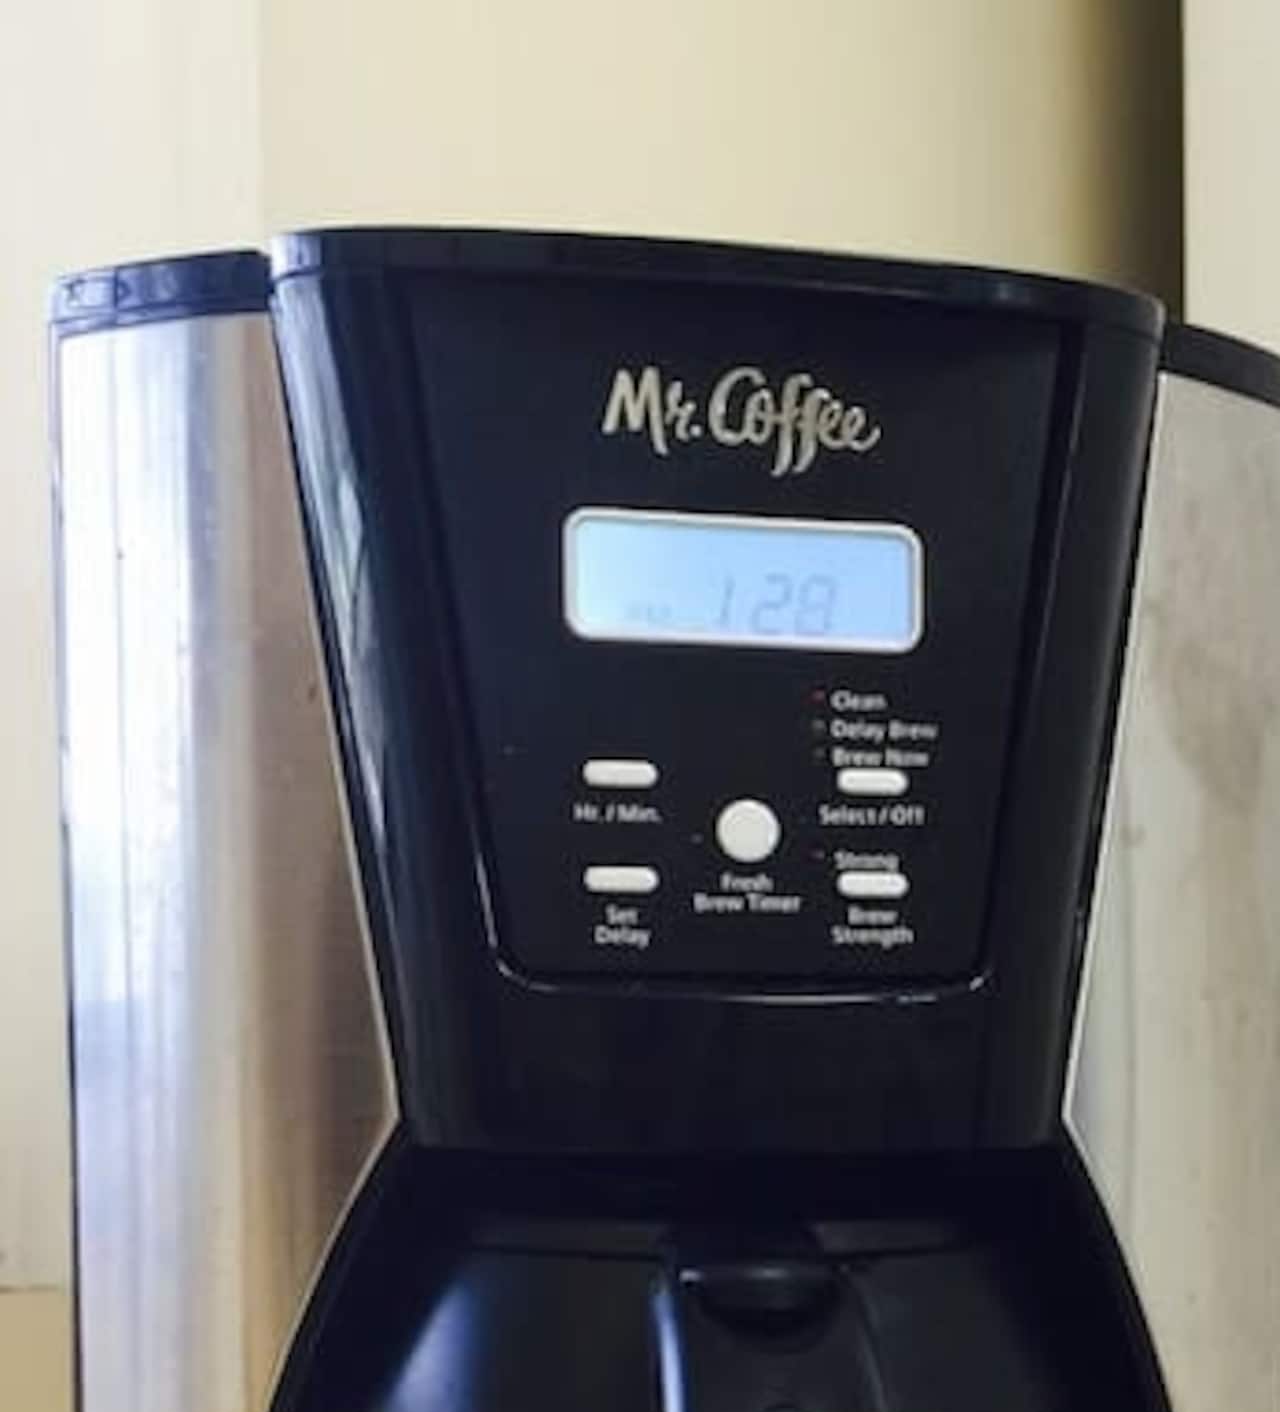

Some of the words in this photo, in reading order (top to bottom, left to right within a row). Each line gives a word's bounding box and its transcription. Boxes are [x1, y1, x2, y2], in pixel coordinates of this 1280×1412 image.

[602, 366, 701, 455] Mr.
[708, 366, 881, 477] Coffee
[831, 690, 887, 711] Clean
[831, 719, 884, 742] Delay
[889, 720, 938, 739] Brew
[833, 747, 882, 766] Brew
[886, 748, 929, 767] Now
[834, 850, 899, 872] Strong
[721, 872, 773, 892] Fresh
[694, 892, 745, 913] Brew
[746, 892, 801, 913] Timer
[606, 903, 639, 926] Set
[848, 906, 898, 926] Brew
[595, 925, 650, 949] Delay
[831, 924, 915, 949] Strength
